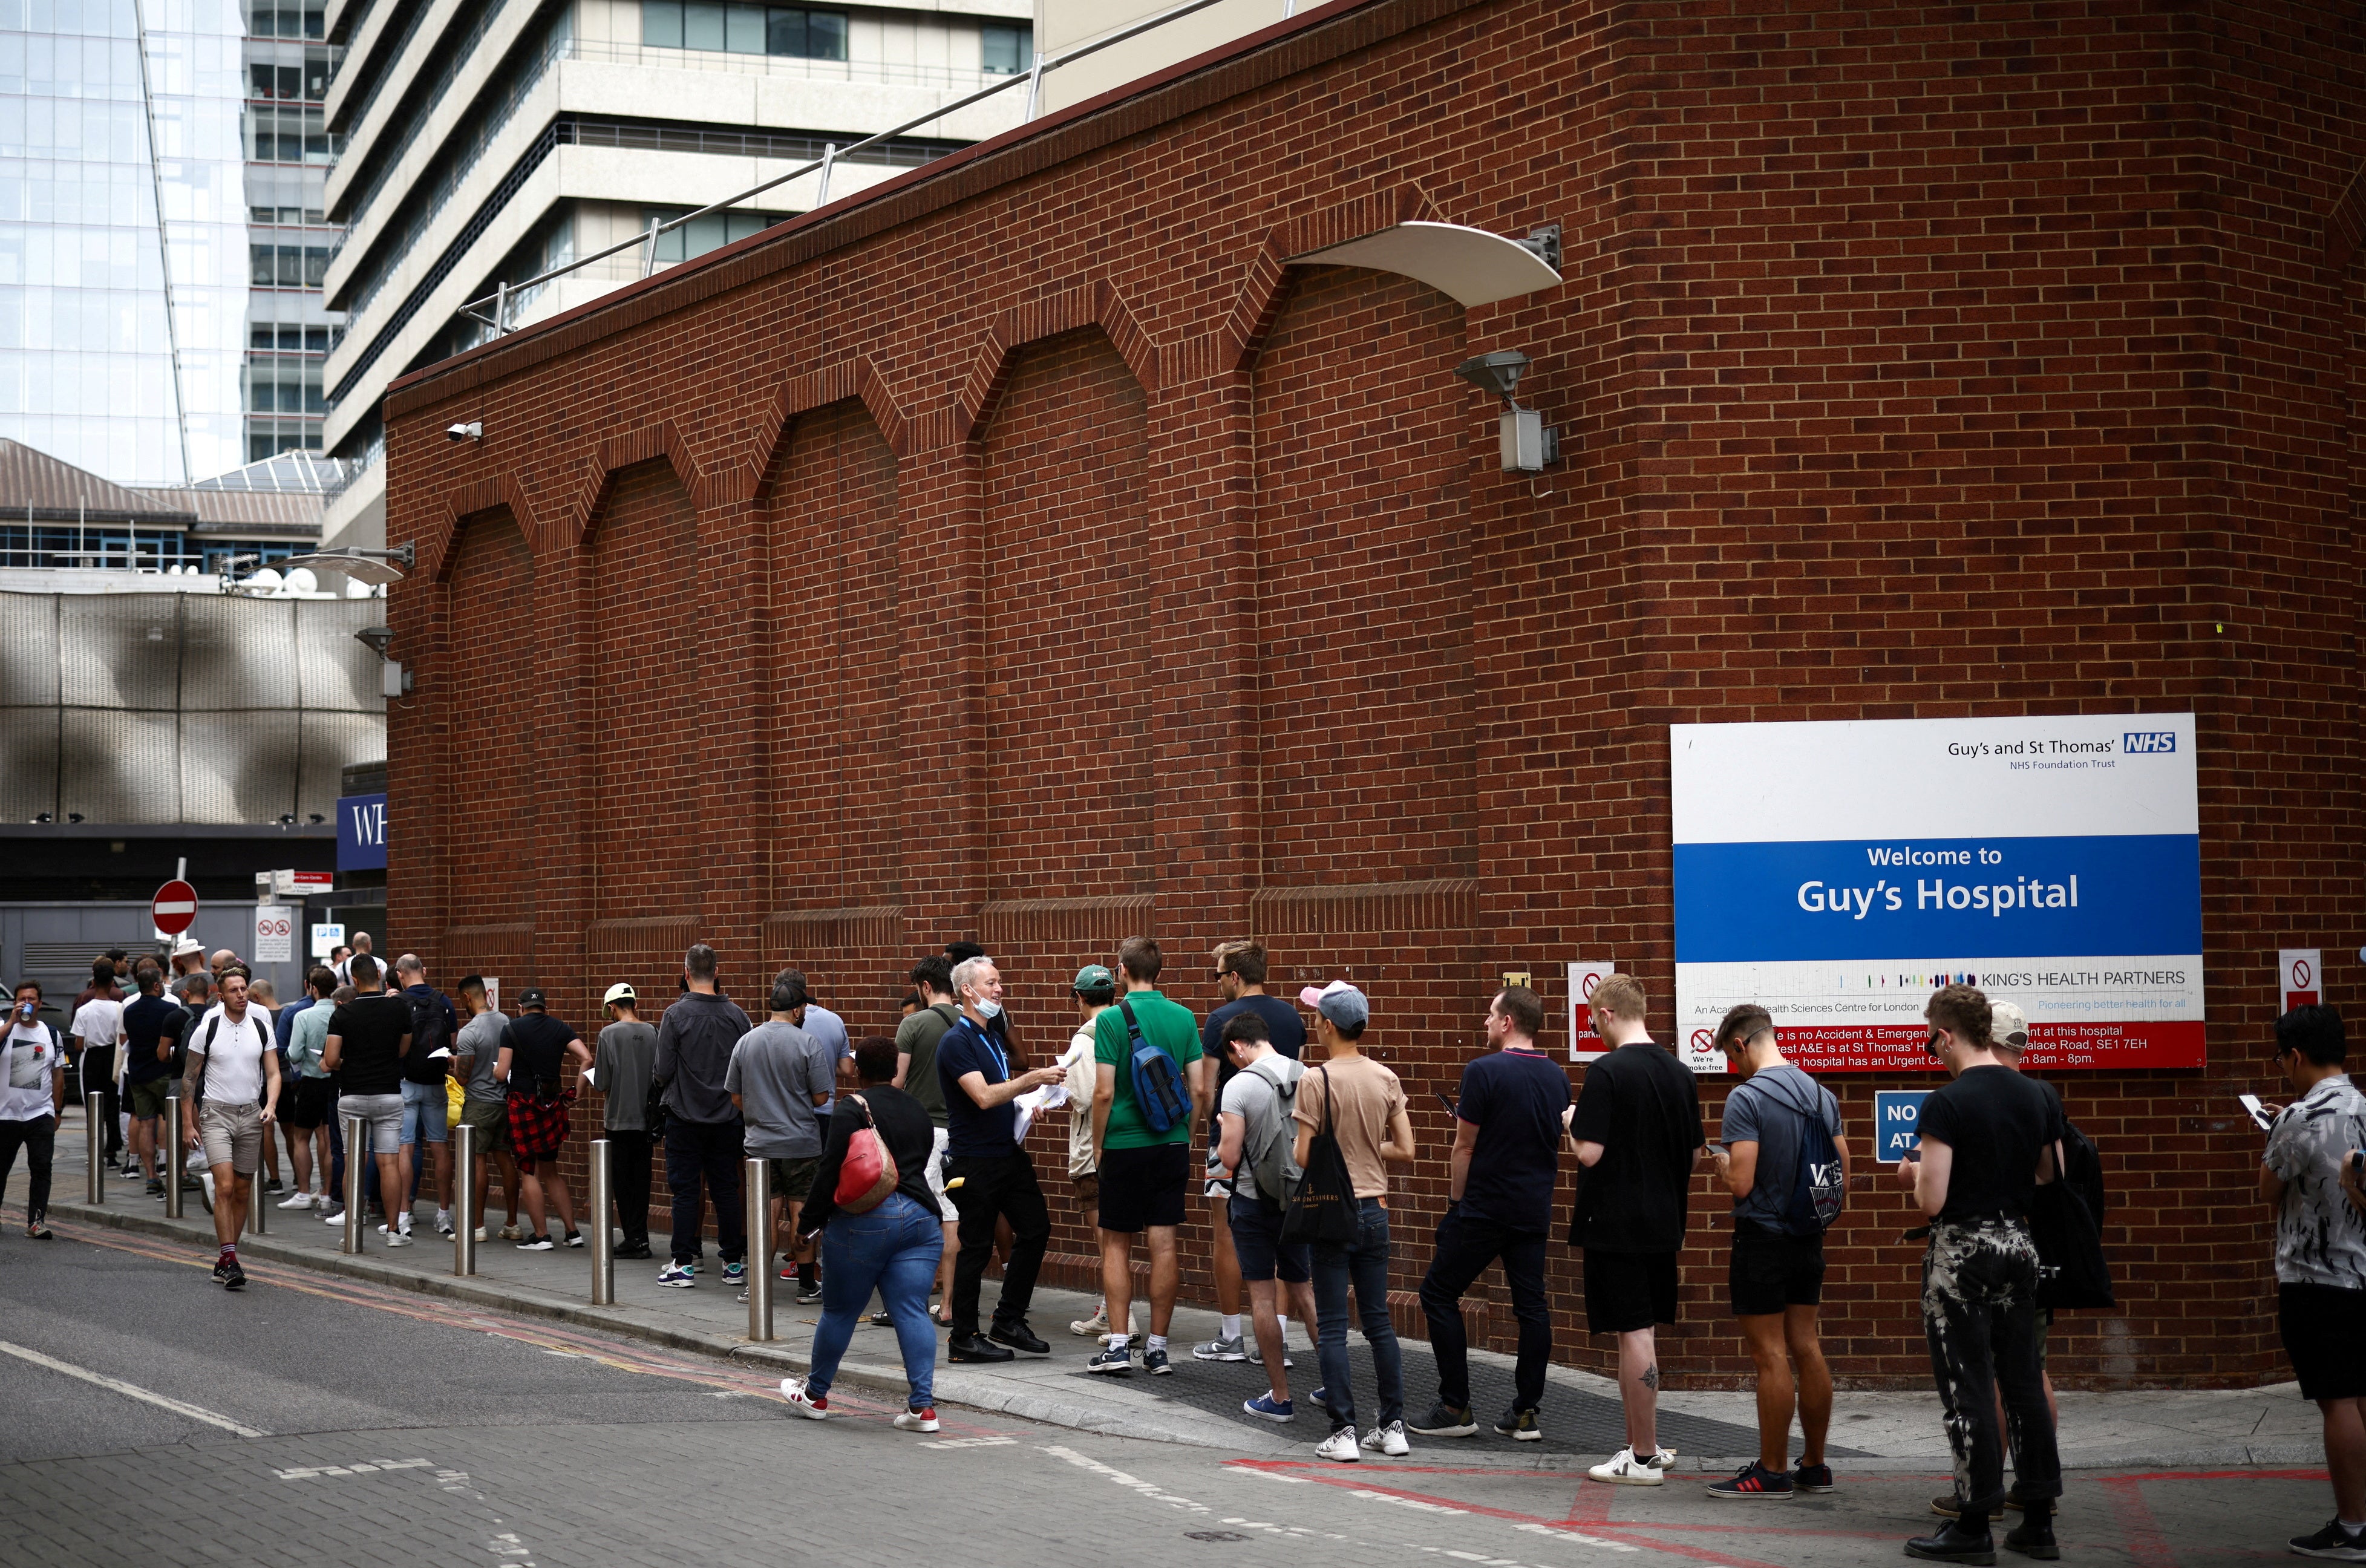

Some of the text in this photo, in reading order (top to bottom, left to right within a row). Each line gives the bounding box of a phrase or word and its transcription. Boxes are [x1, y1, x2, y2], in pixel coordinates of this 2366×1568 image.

[1948, 733, 2174, 759] Guy's and St Thomas' NHS
[2010, 760, 2116, 769] NHS Foundation Trust
[1867, 846, 2002, 866] Welcome to
[1797, 874, 2078, 920] Guy's Hospital
[1982, 971, 2185, 987] KING'S HEALTH PARTNERS
[1694, 1005, 1708, 1014] An
[1791, 1004, 1832, 1013] Sciences
[1835, 1003, 1866, 1012] Centre
[1868, 1002, 1882, 1011] for
[1884, 1002, 1919, 1011] London
[2038, 999, 2186, 1011] Pioneering better health for all
[1787, 1030, 1796, 1040] is
[1799, 1031, 1813, 1040] no
[1815, 1029, 1862, 1040] Accident
[1866, 1029, 1874, 1039] &
[2044, 1027, 2054, 1036] at
[2057, 1027, 2077, 1036] this
[2080, 1026, 2123, 1038] hospital
[1799, 1043, 1823, 1053] A&E
[1827, 1043, 1836, 1053] is
[1839, 1043, 1849, 1053] at
[1852, 1042, 1864, 1053] St
[1867, 1042, 1913, 1052] Thomas'
[2027, 1040, 2056, 1050] alace
[2060, 1040, 2093, 1051] Road,
[2096, 1039, 2119, 1050] SE1
[2123, 1039, 2148, 1050] 7EH
[1785, 1057, 1800, 1067] his
[1803, 1056, 1845, 1069] hospital
[1848, 1056, 1868, 1067] has
[1888, 1056, 1925, 1068] Urgent
[1928, 1055, 1944, 1065] Ca
[2033, 1053, 2057, 1064] 8am
[2068, 1053, 2095, 1065] 8pm.
[1887, 1105, 1917, 1121] NO
[1889, 1132, 1914, 1148] AT
